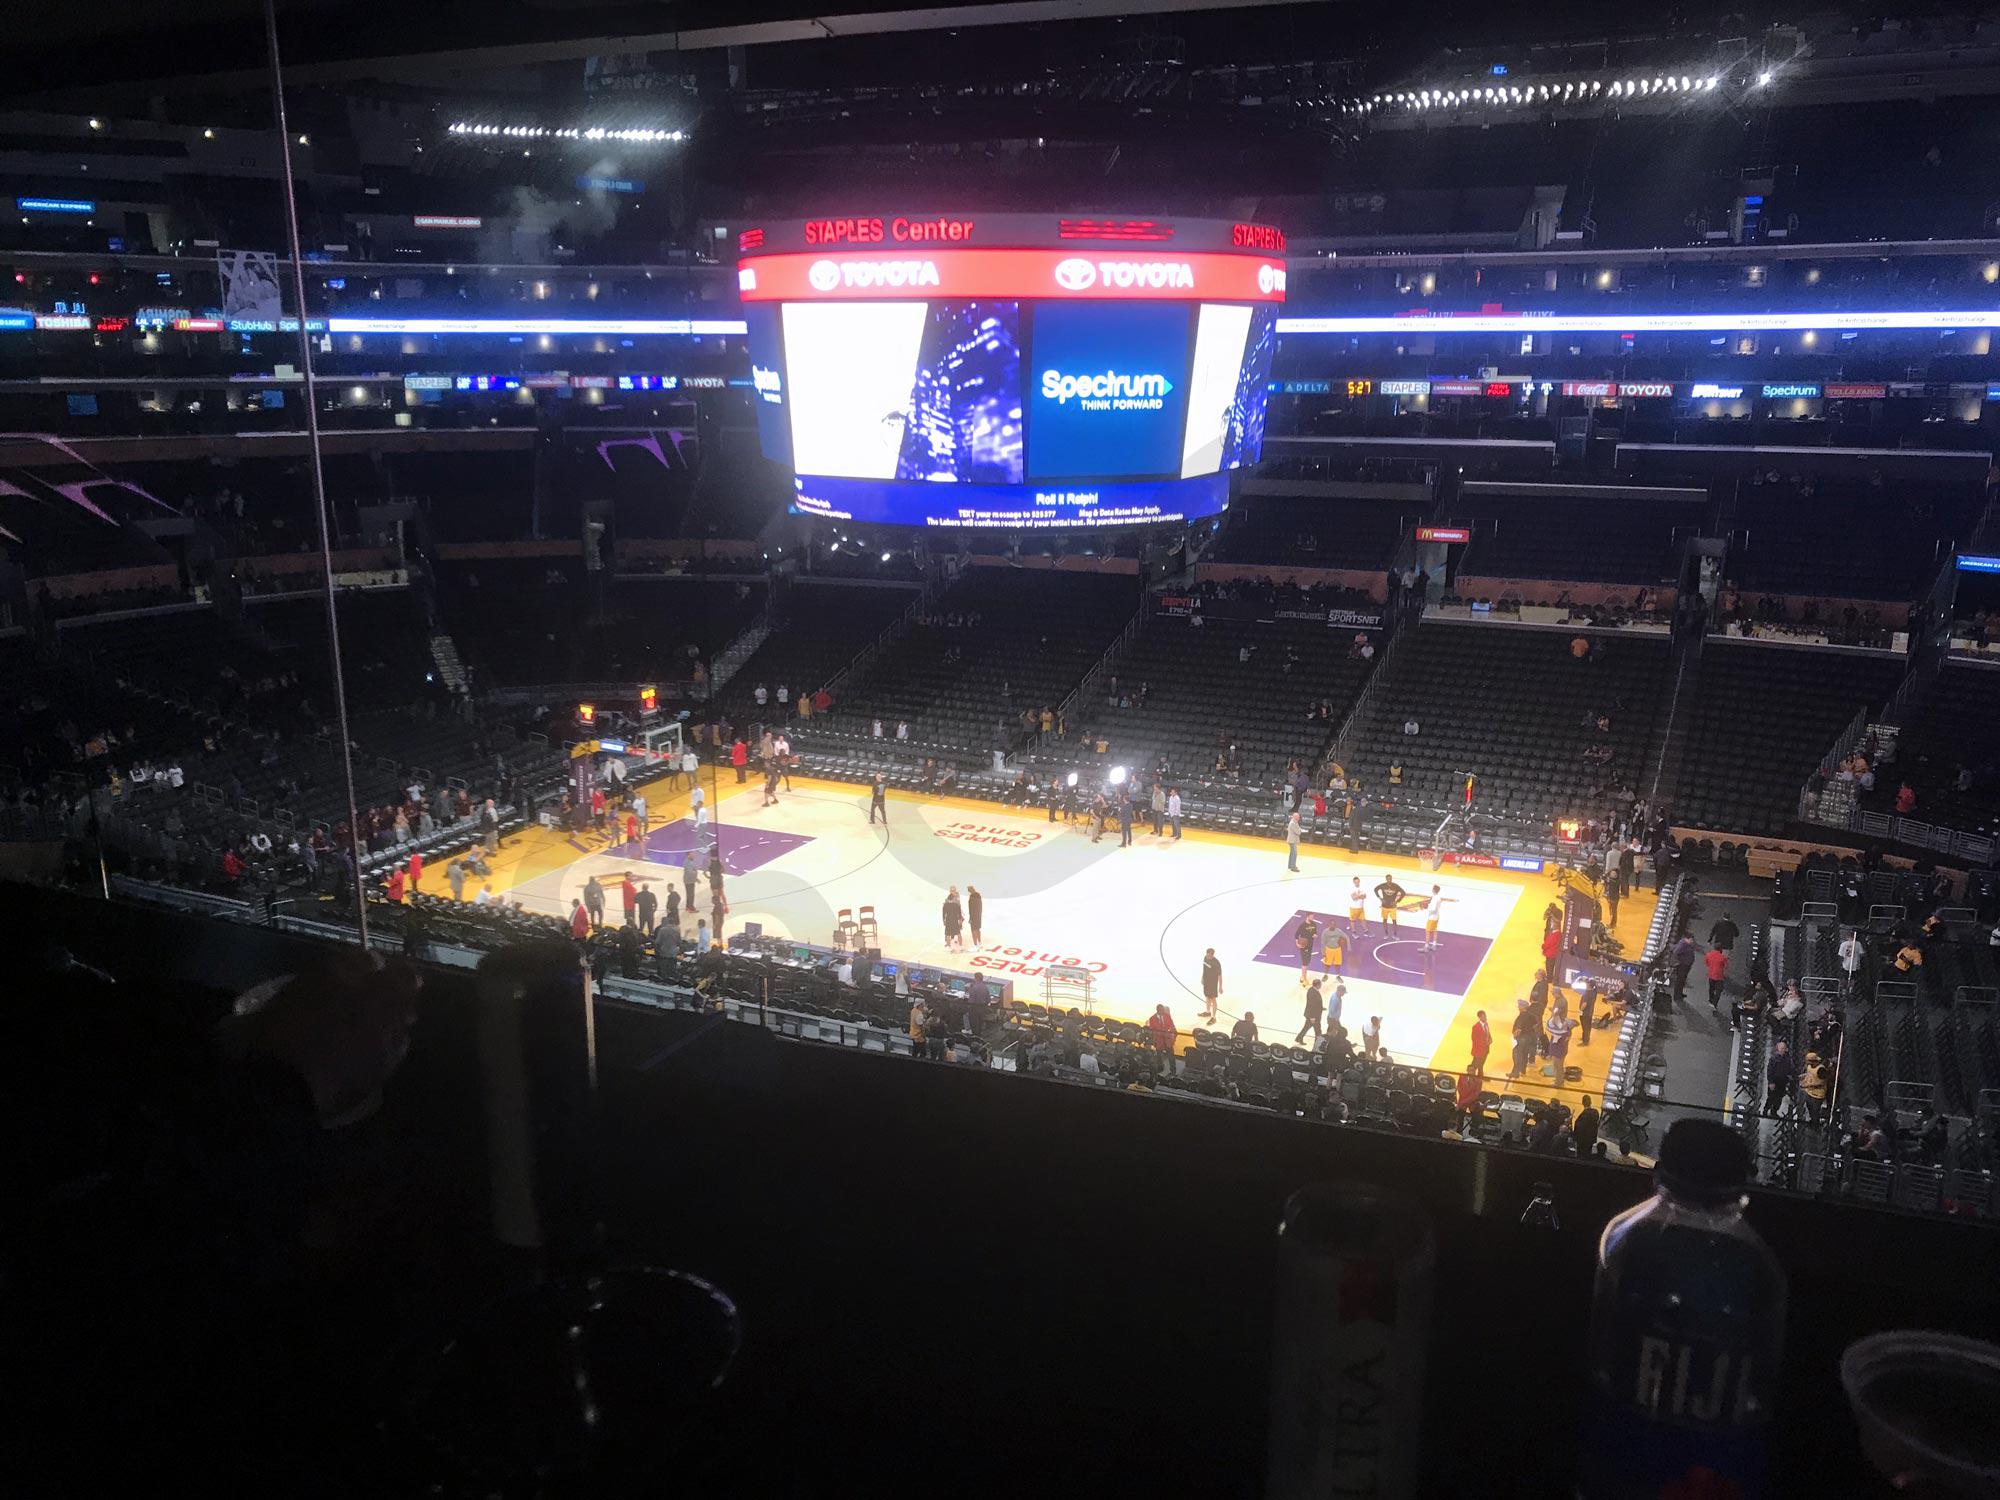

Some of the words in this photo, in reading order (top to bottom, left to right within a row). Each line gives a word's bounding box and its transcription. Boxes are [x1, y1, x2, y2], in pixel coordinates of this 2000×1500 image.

[22, 201, 60, 209] AMERICAN
[805, 218, 884, 244] STAPLES
[891, 217, 974, 242] Center
[1232, 224, 1276, 250] STAPLES
[840, 261, 940, 287] TOYOTA
[1099, 262, 1194, 288] TOYOTA
[39, 317, 90, 327] TOSHIBA
[231, 320, 273, 330] StubHub
[405, 378, 452, 388] STAPLES
[1042, 369, 1165, 404] Spectrum
[1296, 384, 1329, 392] DELTA
[1347, 381, 1371, 395] 5:27
[1382, 382, 1429, 393] STAPLES
[1618, 384, 1673, 396] TOYOTA
[1762, 385, 1816, 397] Spectrum
[1081, 399, 1111, 411] THINK
[1113, 399, 1163, 410] FORWARD
[1036, 493, 1056, 505] Roll
[958, 509, 975, 518] TEXT
[976, 511, 992, 519] your
[992, 511, 1022, 519] message
[1079, 509, 1092, 518] Msg
[1100, 508, 1114, 516] Data
[1115, 508, 1131, 516] Rates
[1131, 507, 1144, 516] May
[927, 517, 939, 525] The
[939, 518, 961, 526] Lakers
[1001, 519, 1025, 528] receipt
[1025, 519, 1033, 527] of
[1033, 520, 1050, 528] your
[1086, 518, 1096, 526] No
[1096, 517, 1124, 526] purchase
[1959, 560, 1993, 568] AMERICAN
[1327, 614, 1381, 625] SPORTSNET
[946, 822, 1042, 841] Center
[934, 829, 1032, 849] STAPLES
[1461, 855, 1493, 866] AAA.com
[985, 945, 1108, 973] Center
[1331, 1349, 1384, 1500] LTRA
